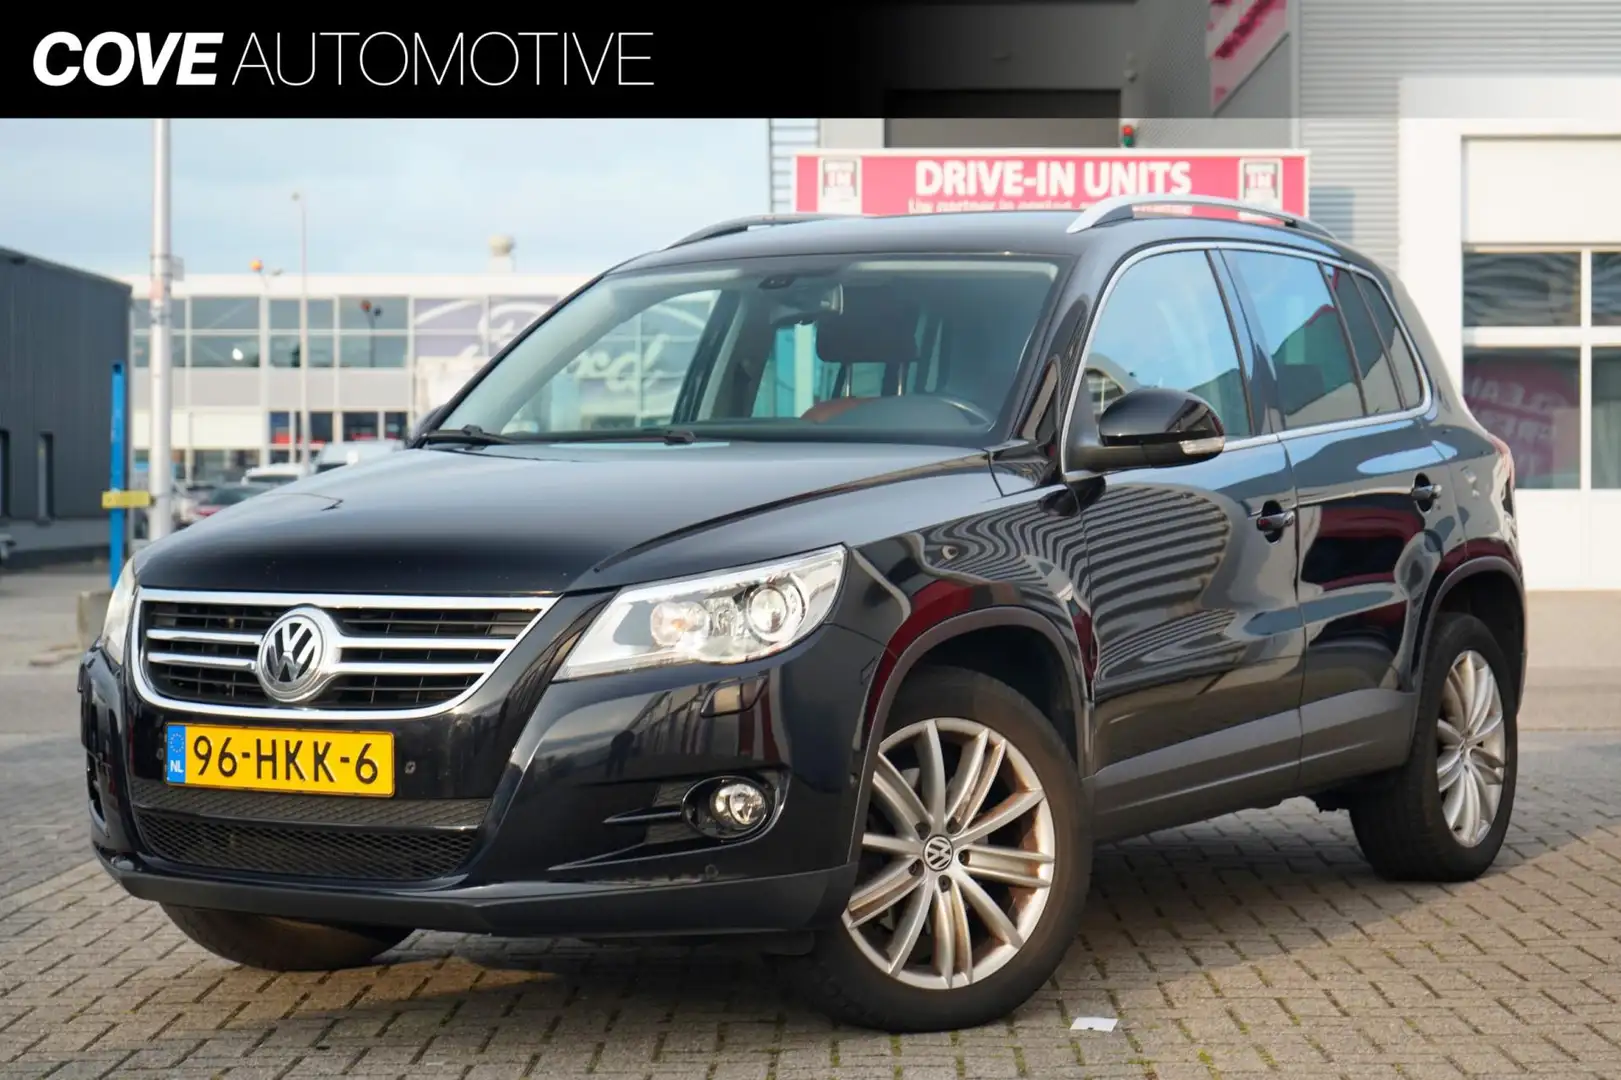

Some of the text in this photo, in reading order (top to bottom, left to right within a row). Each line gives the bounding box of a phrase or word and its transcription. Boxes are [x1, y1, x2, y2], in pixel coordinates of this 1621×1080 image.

[915, 160, 1193, 197] DRIVE-IN UNITS
[169, 760, 184, 774] NL
[192, 734, 380, 785] 96-HKK-6
